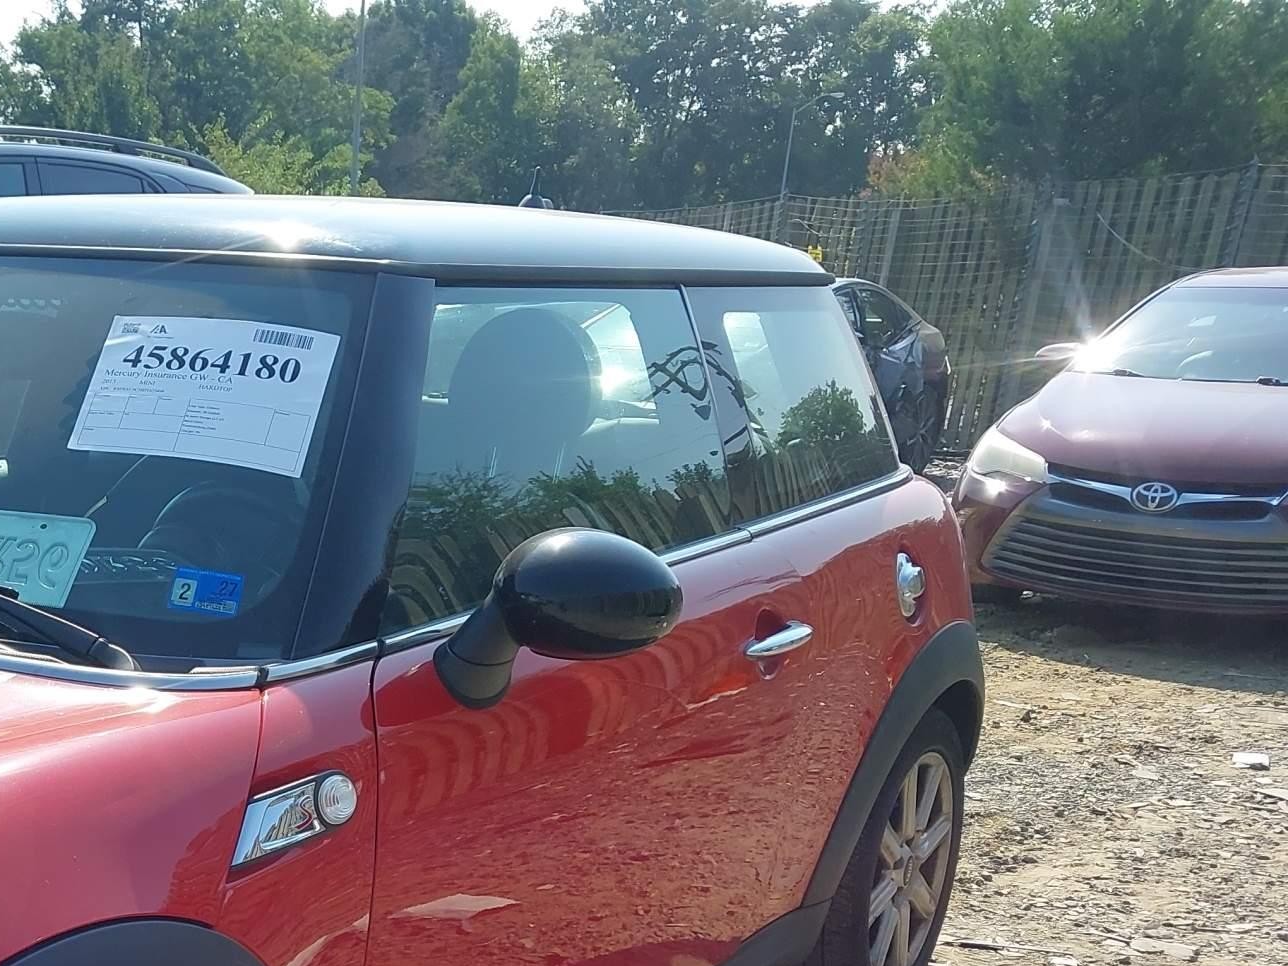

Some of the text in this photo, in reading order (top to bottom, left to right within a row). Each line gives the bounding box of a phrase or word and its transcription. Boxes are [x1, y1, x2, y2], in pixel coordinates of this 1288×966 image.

[122, 345, 302, 383] 45864180
[104, 369, 141, 378] Mercury
[144, 370, 187, 380] Insurance
[190, 373, 209, 382] GW
[218, 375, 233, 384] CA
[198, 384, 233, 392] HARDTOP
[178, 582, 191, 600] 2
[218, 580, 238, 595] 27
